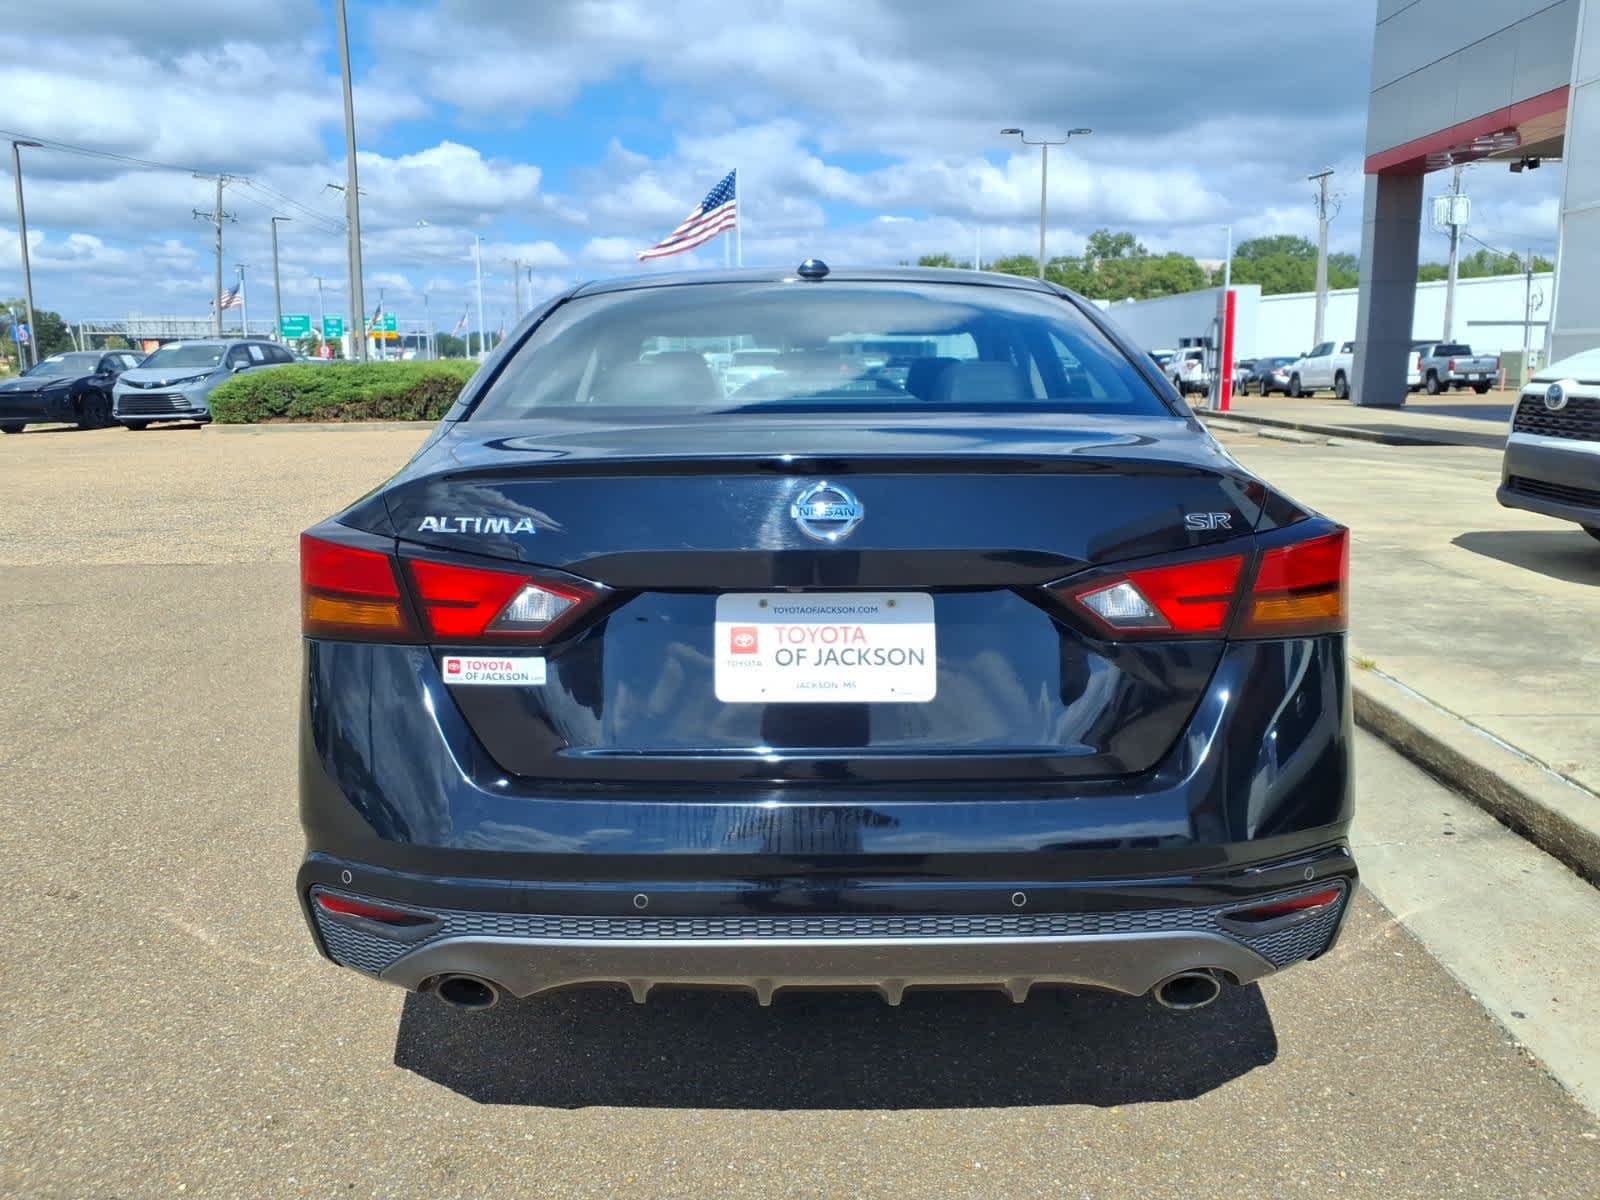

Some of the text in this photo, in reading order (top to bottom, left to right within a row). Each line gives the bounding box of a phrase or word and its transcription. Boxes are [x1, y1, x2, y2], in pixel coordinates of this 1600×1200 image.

[799, 507, 855, 517] NISAN
[418, 516, 536, 534] ALTIMA
[1185, 512, 1232, 530] SR
[773, 606, 879, 615] TOYOTAOFJACKSON.COM
[775, 626, 867, 645] TOYOTA
[775, 648, 925, 667] OF JACKSON
[466, 661, 513, 671] TOYOTA
[727, 660, 763, 668] TOYOTA
[465, 672, 480, 681] OF
[481, 672, 529, 681] JACKSON
